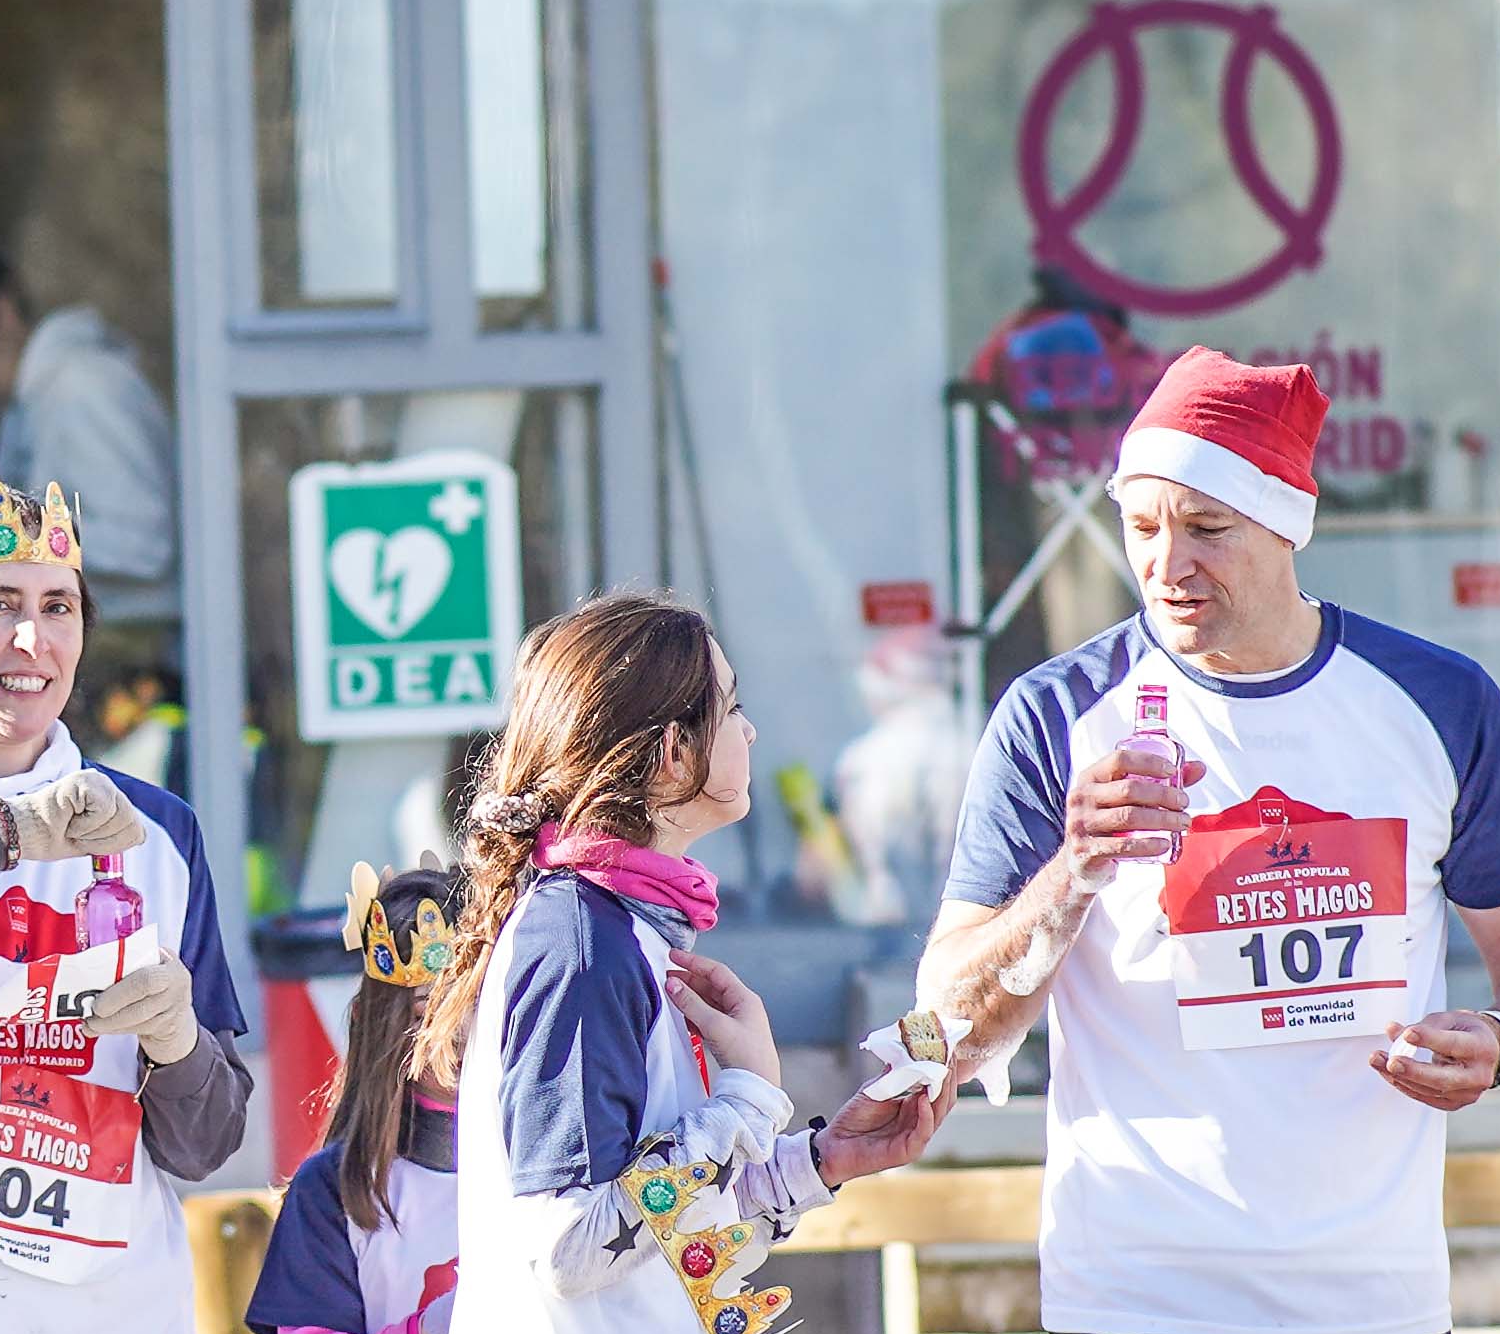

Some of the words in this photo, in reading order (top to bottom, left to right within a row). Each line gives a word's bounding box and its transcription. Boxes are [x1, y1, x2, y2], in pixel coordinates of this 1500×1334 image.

[336, 651, 488, 707] DEA
[1236, 868, 1292, 887] CARRERA
[1293, 866, 1351, 878] POPULAR
[1215, 889, 1288, 925] REYES
[1295, 880, 1374, 919] MAGOS
[1239, 923, 1364, 988] 107
[1286, 998, 1355, 1014] Comunidad
[1288, 1016, 1305, 1028] de
[1309, 1011, 1356, 1026] Madrid
[39, 1056, 86, 1068] MADRID
[29, 1111, 78, 1135] POPULAR
[21, 1128, 91, 1173] MAGOS
[9, 1247, 50, 1264] Madrid
